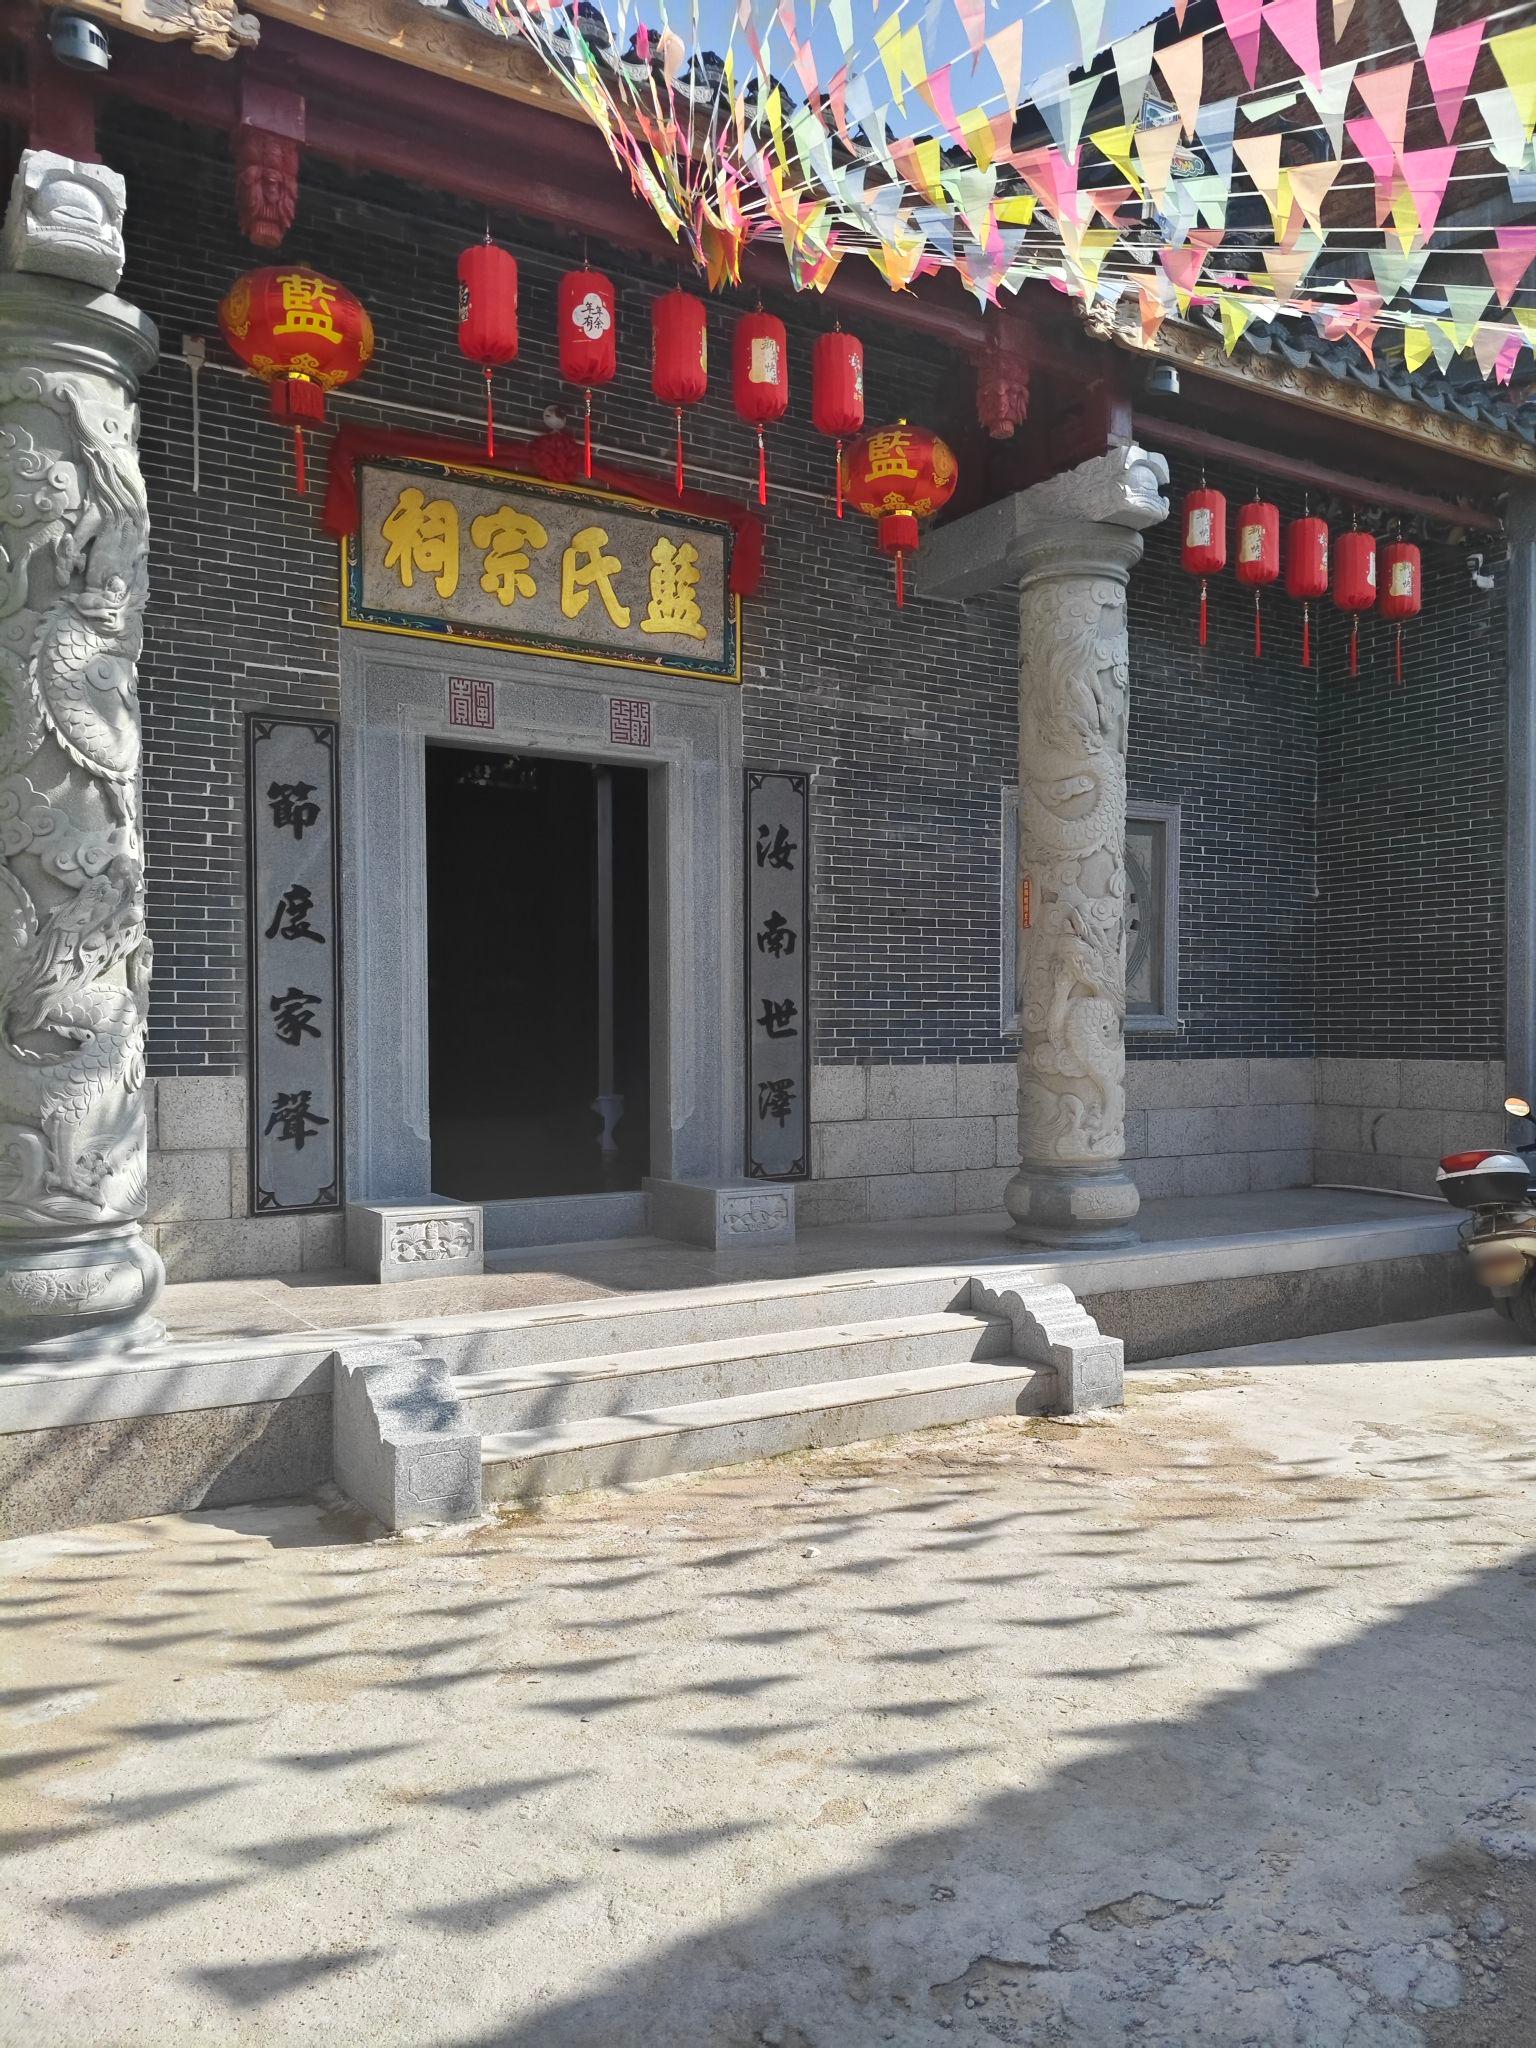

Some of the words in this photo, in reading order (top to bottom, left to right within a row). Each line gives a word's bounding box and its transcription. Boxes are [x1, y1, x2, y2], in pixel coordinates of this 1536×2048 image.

[265, 781, 330, 1151] 節度家聲
[756, 824, 798, 1128] 汝南世澤
